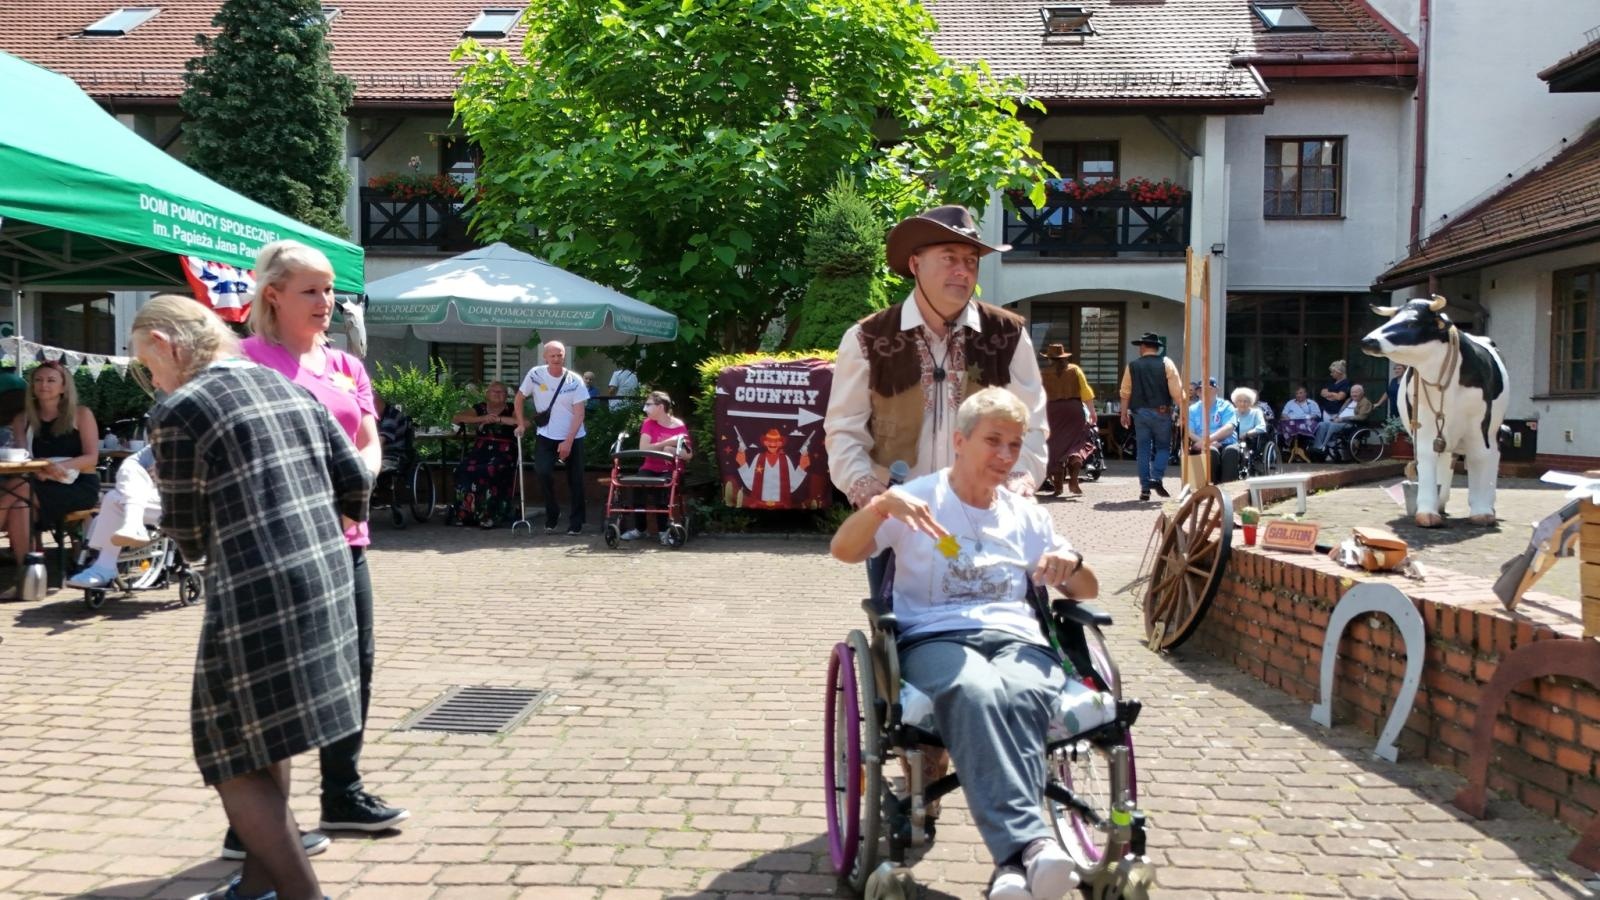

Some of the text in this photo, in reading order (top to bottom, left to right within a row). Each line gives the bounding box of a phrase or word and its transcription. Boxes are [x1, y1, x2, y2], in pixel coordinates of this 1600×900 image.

[139, 193, 168, 216] DOM
[170, 203, 218, 230] POMOCY
[152, 219, 170, 238] im.
[172, 224, 213, 247] Papieża
[215, 236, 238, 254] Jana
[468, 305, 492, 316] DOM
[494, 306, 536, 317] POMOCY
[745, 368, 810, 386] PIKNIK
[735, 386, 819, 405] COUNTRY
[1268, 527, 1312, 541] SALOON
